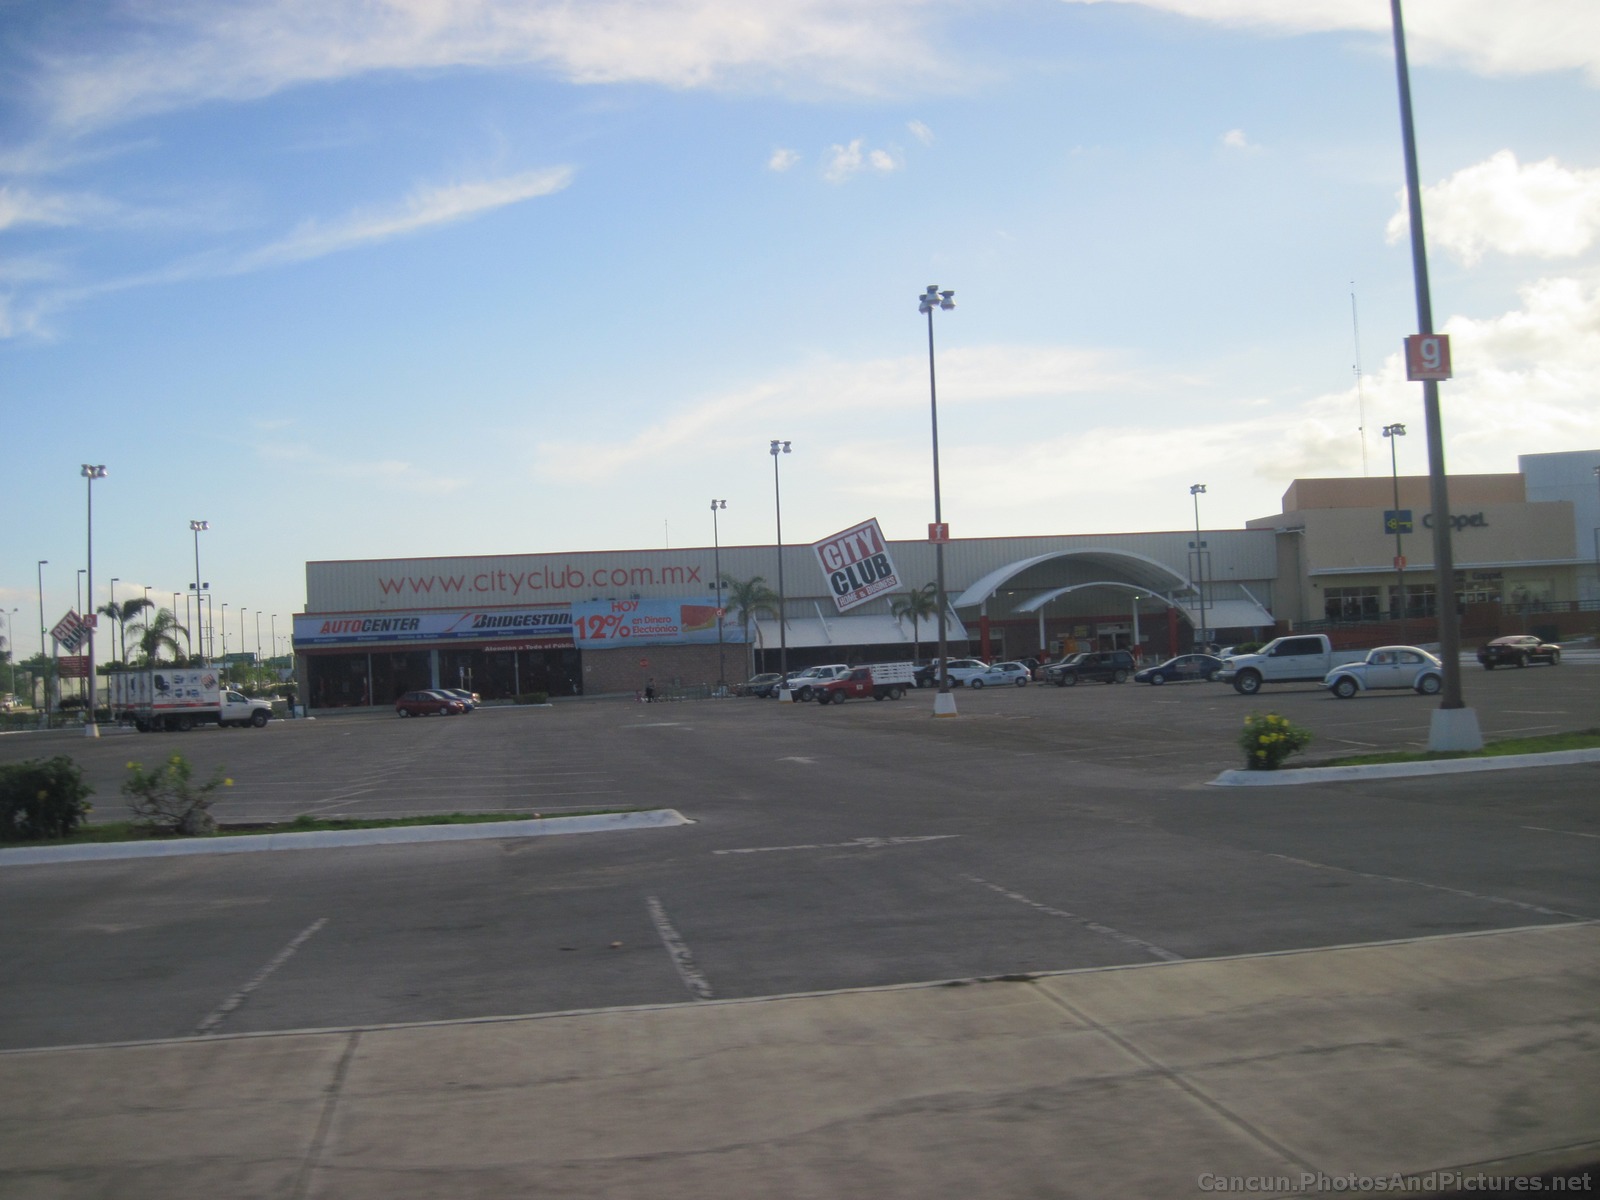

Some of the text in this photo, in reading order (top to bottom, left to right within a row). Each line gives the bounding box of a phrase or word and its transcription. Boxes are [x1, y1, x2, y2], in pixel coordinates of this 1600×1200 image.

[935, 525, 943, 539] f
[1422, 511, 1489, 532] Cpel
[822, 527, 877, 570] CITY
[378, 564, 701, 596] www.cityclub.com.mx
[830, 553, 892, 596] CLUB
[611, 600, 639, 612] HOY
[53, 613, 78, 639] CITY
[320, 617, 420, 635] AUTOCENTER
[574, 614, 631, 640] 12%
[644, 616, 672, 624] Dinero
